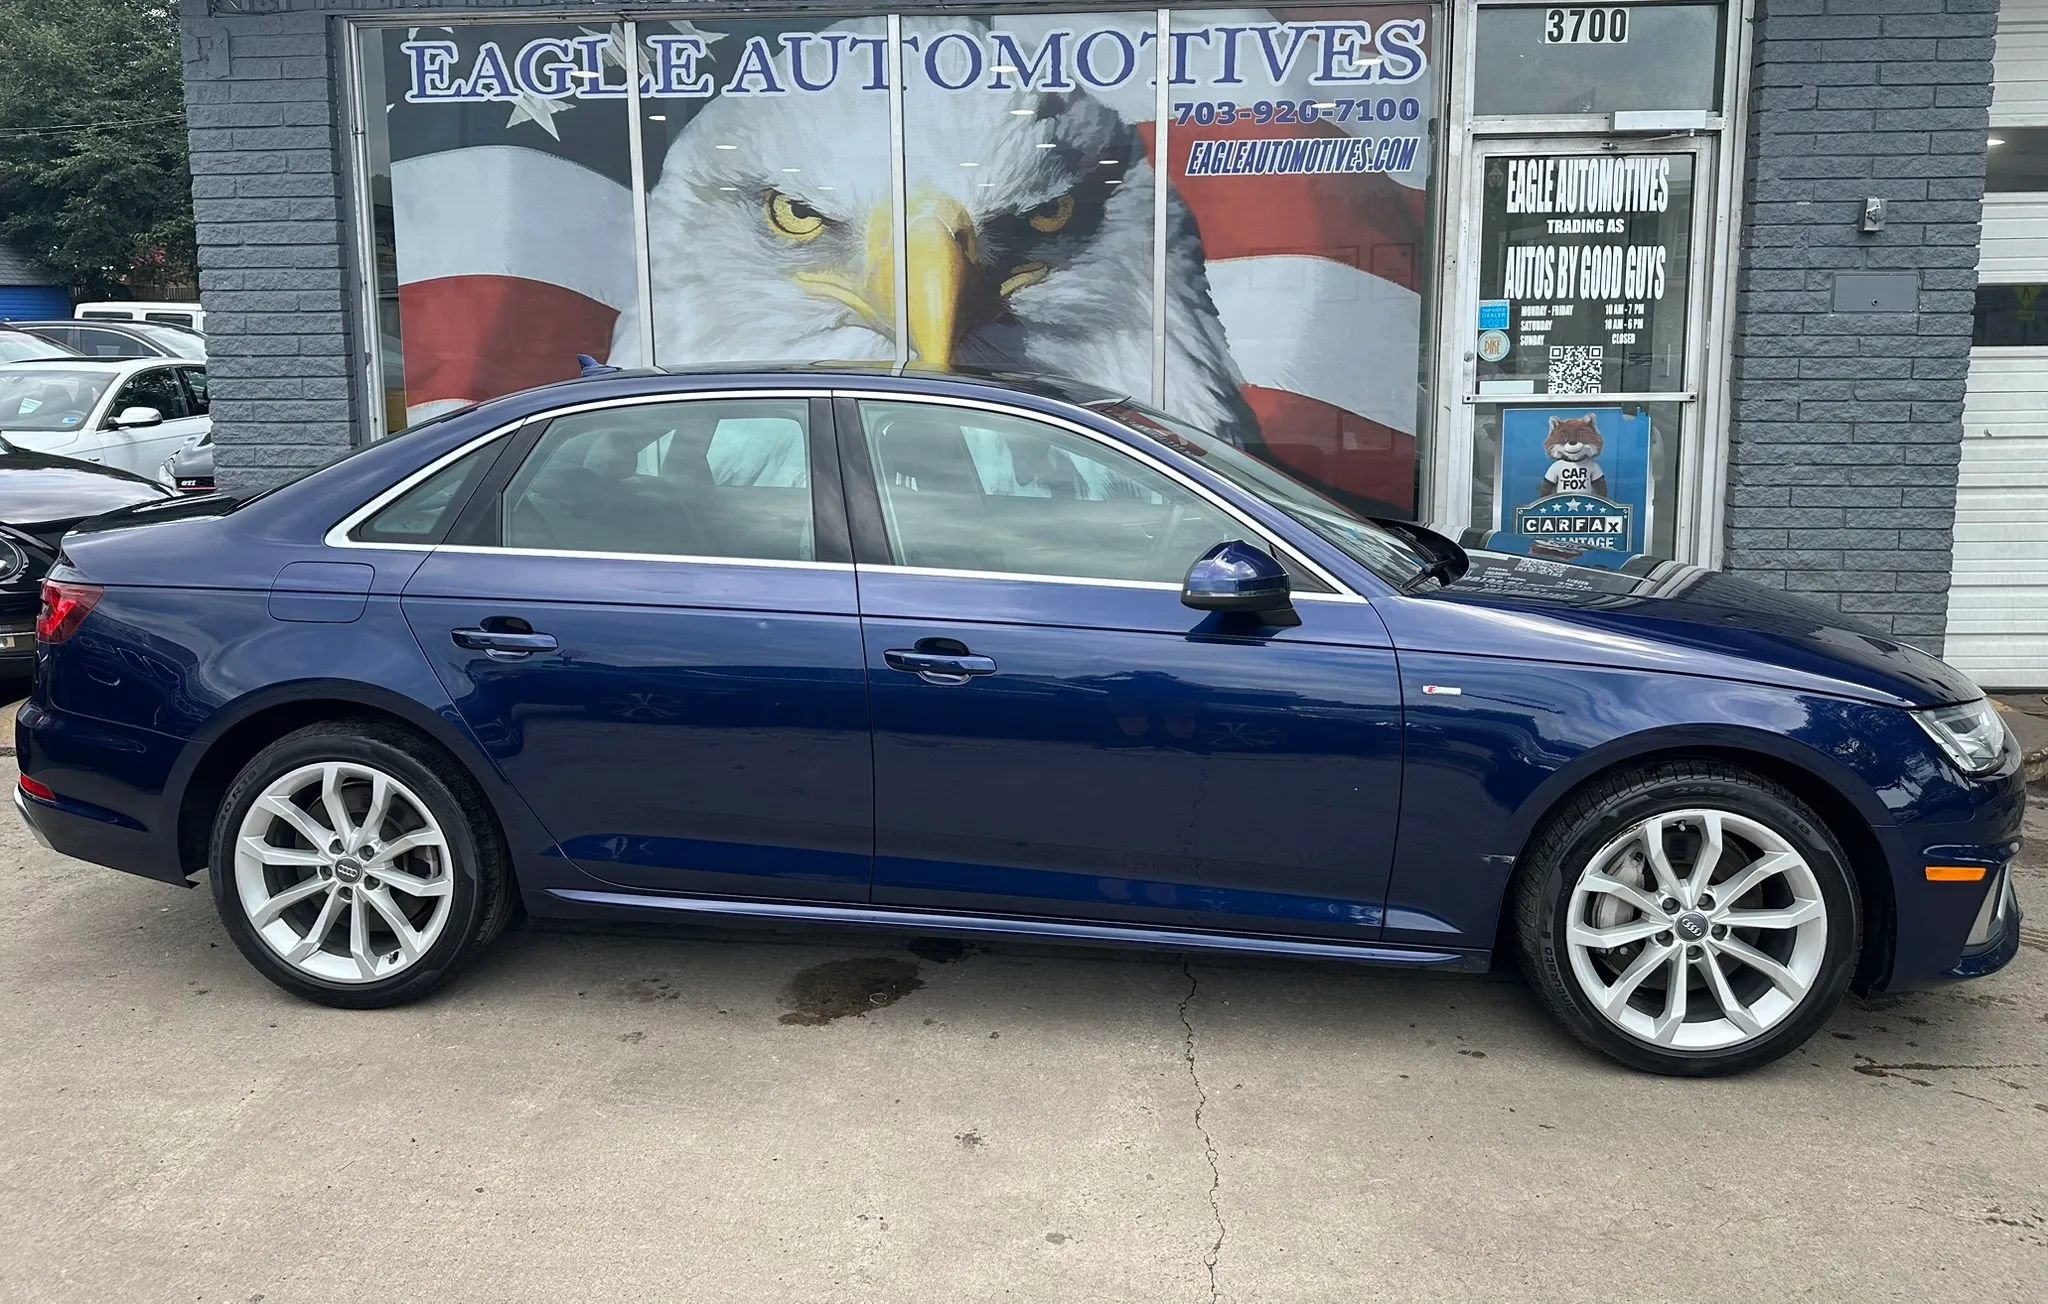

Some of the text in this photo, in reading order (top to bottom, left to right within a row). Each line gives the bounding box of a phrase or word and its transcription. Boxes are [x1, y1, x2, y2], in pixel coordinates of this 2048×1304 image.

[1547, 9, 1627, 42] 3700
[401, 19, 1427, 103] EAGLE AUTOMOTIVES
[1174, 97, 1420, 126] 703-920-7100
[1185, 136, 1420, 176] EAGLEAUTOMOTIVES.COM
[1506, 158, 1669, 214] EAGLE AUTOMOTIVES
[1547, 219, 1625, 234] TRADING AS
[1504, 244, 1667, 299] AUTOS BY GOOD GUYS
[1521, 305, 1547, 317] MONDAY
[1551, 304, 1574, 316] FRIDAY
[1605, 304, 1613, 315] 10
[1613, 304, 1624, 315] AM
[1634, 303, 1645, 315] PM
[1520, 320, 1553, 331] SATURDAY
[1604, 319, 1613, 330] 10
[1613, 318, 1624, 330] AM
[1633, 318, 1644, 330] PM
[1519, 335, 1545, 346] SUNDAY
[1611, 333, 1636, 344] CLOSED
[1562, 468, 1587, 478] CAR
[1525, 518, 1620, 533] CARFAX
